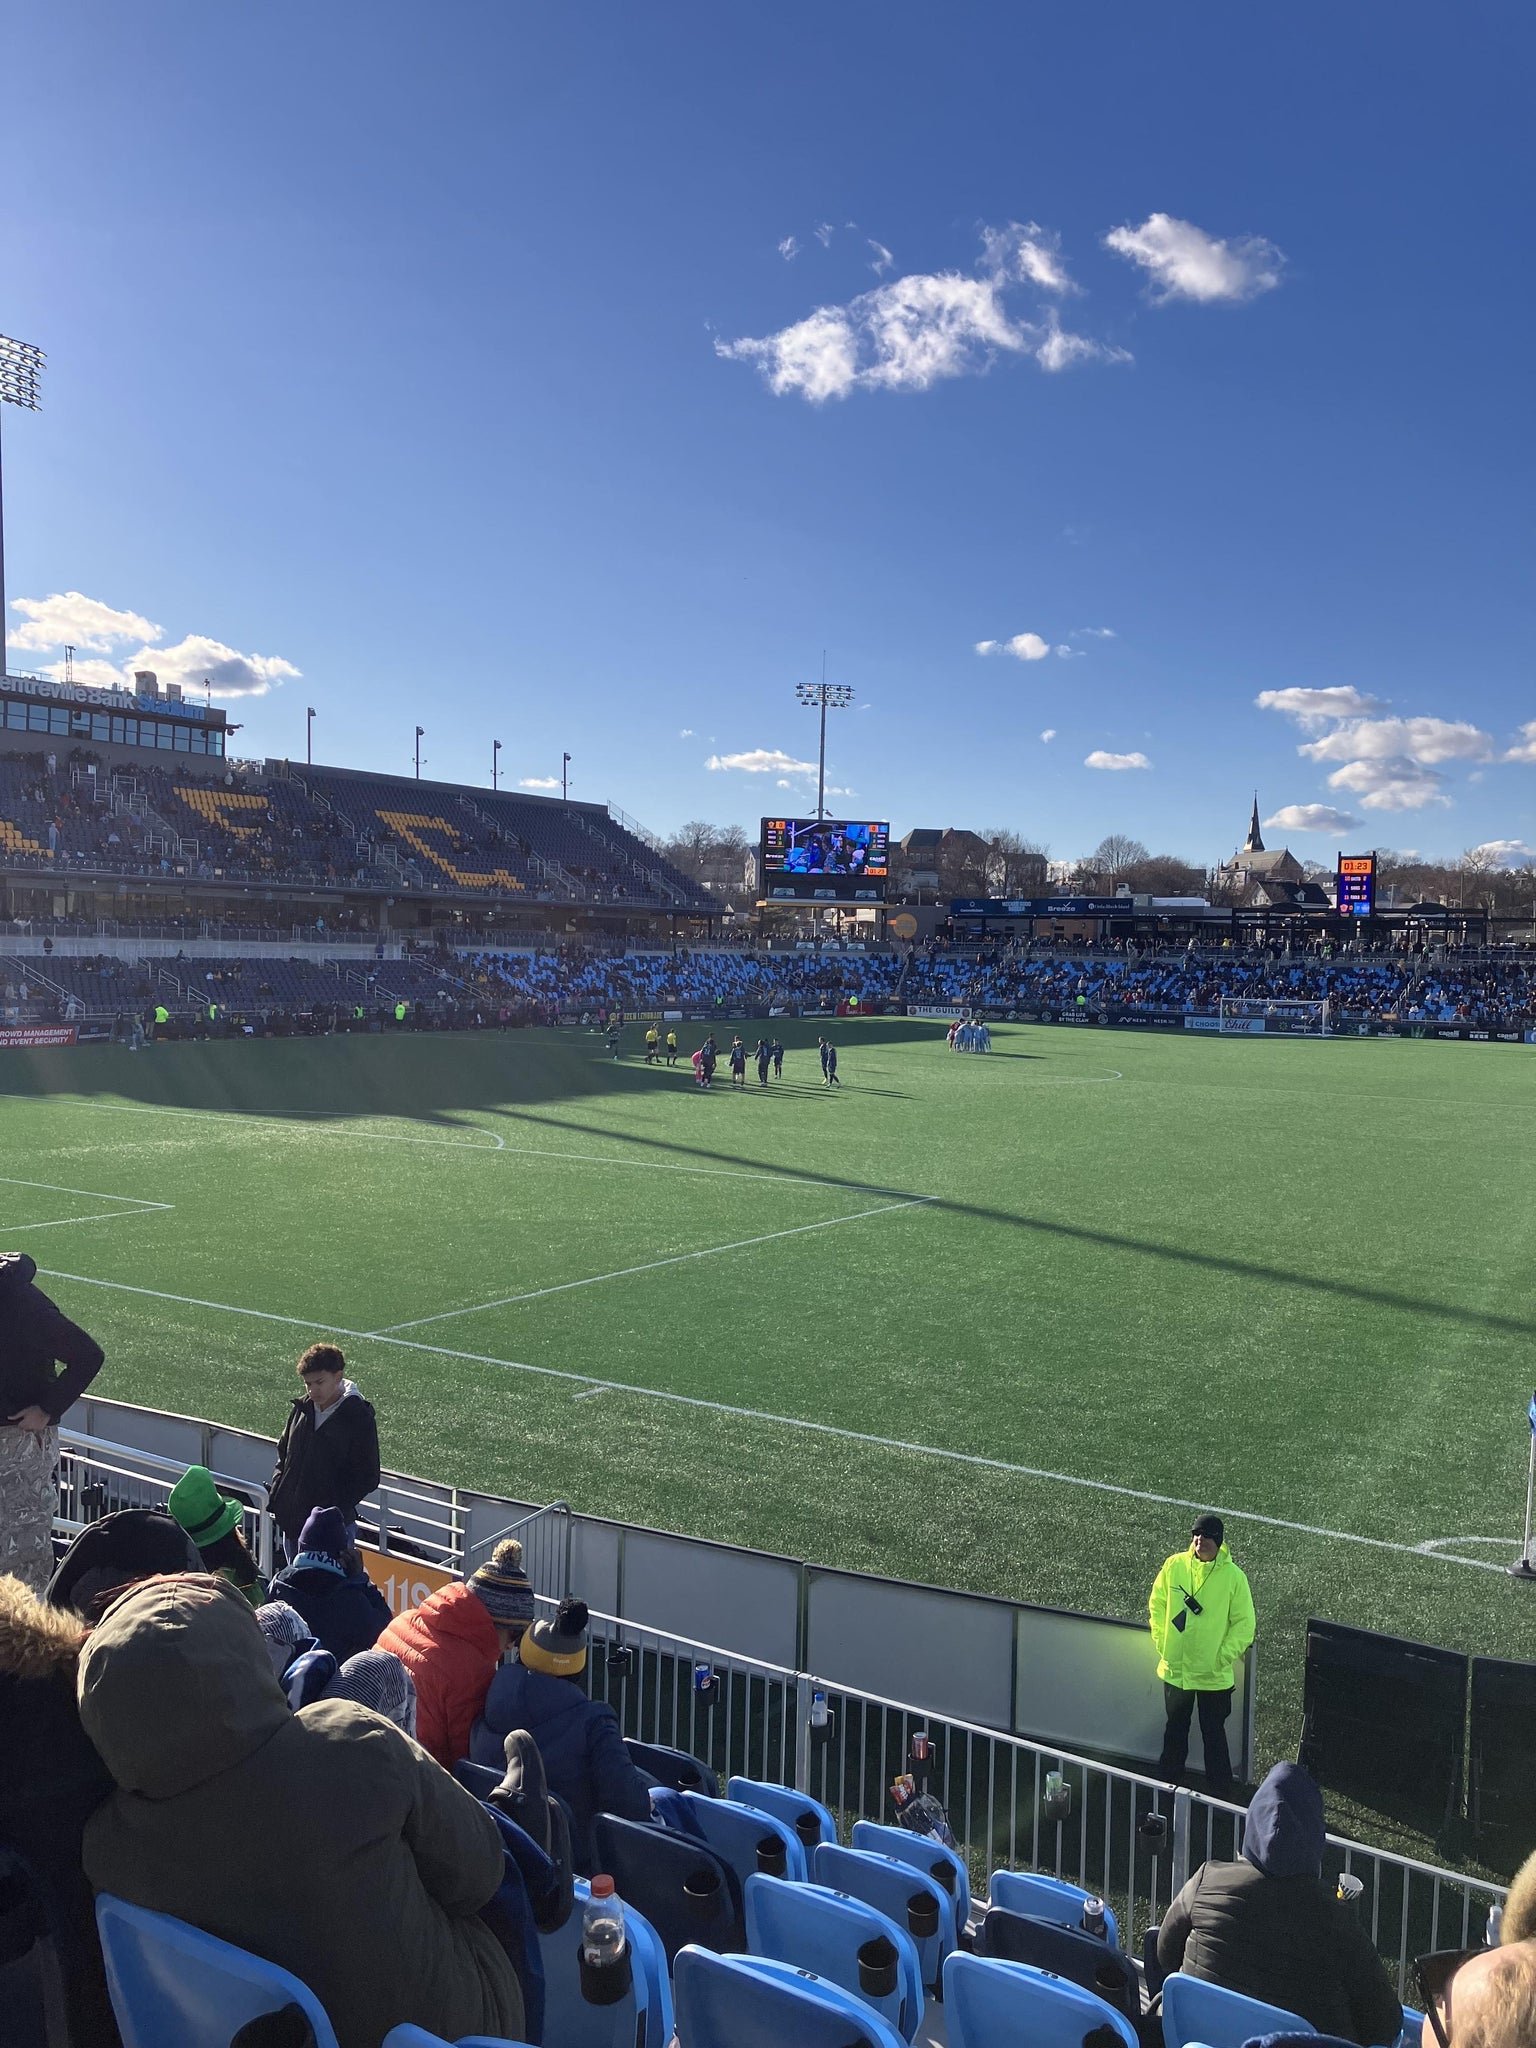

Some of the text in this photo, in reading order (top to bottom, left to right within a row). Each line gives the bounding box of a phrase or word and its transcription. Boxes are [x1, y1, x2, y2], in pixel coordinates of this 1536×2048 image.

[0, 675, 205, 720] entrevilleBank Stadium
[1344, 862, 1368, 870] 01:23
[23, 1028, 73, 1037] MANAGEMENT
[10, 1037, 34, 1045] EVENT
[34, 1036, 69, 1044] SECURITY
[306, 1550, 344, 1570] INAU
